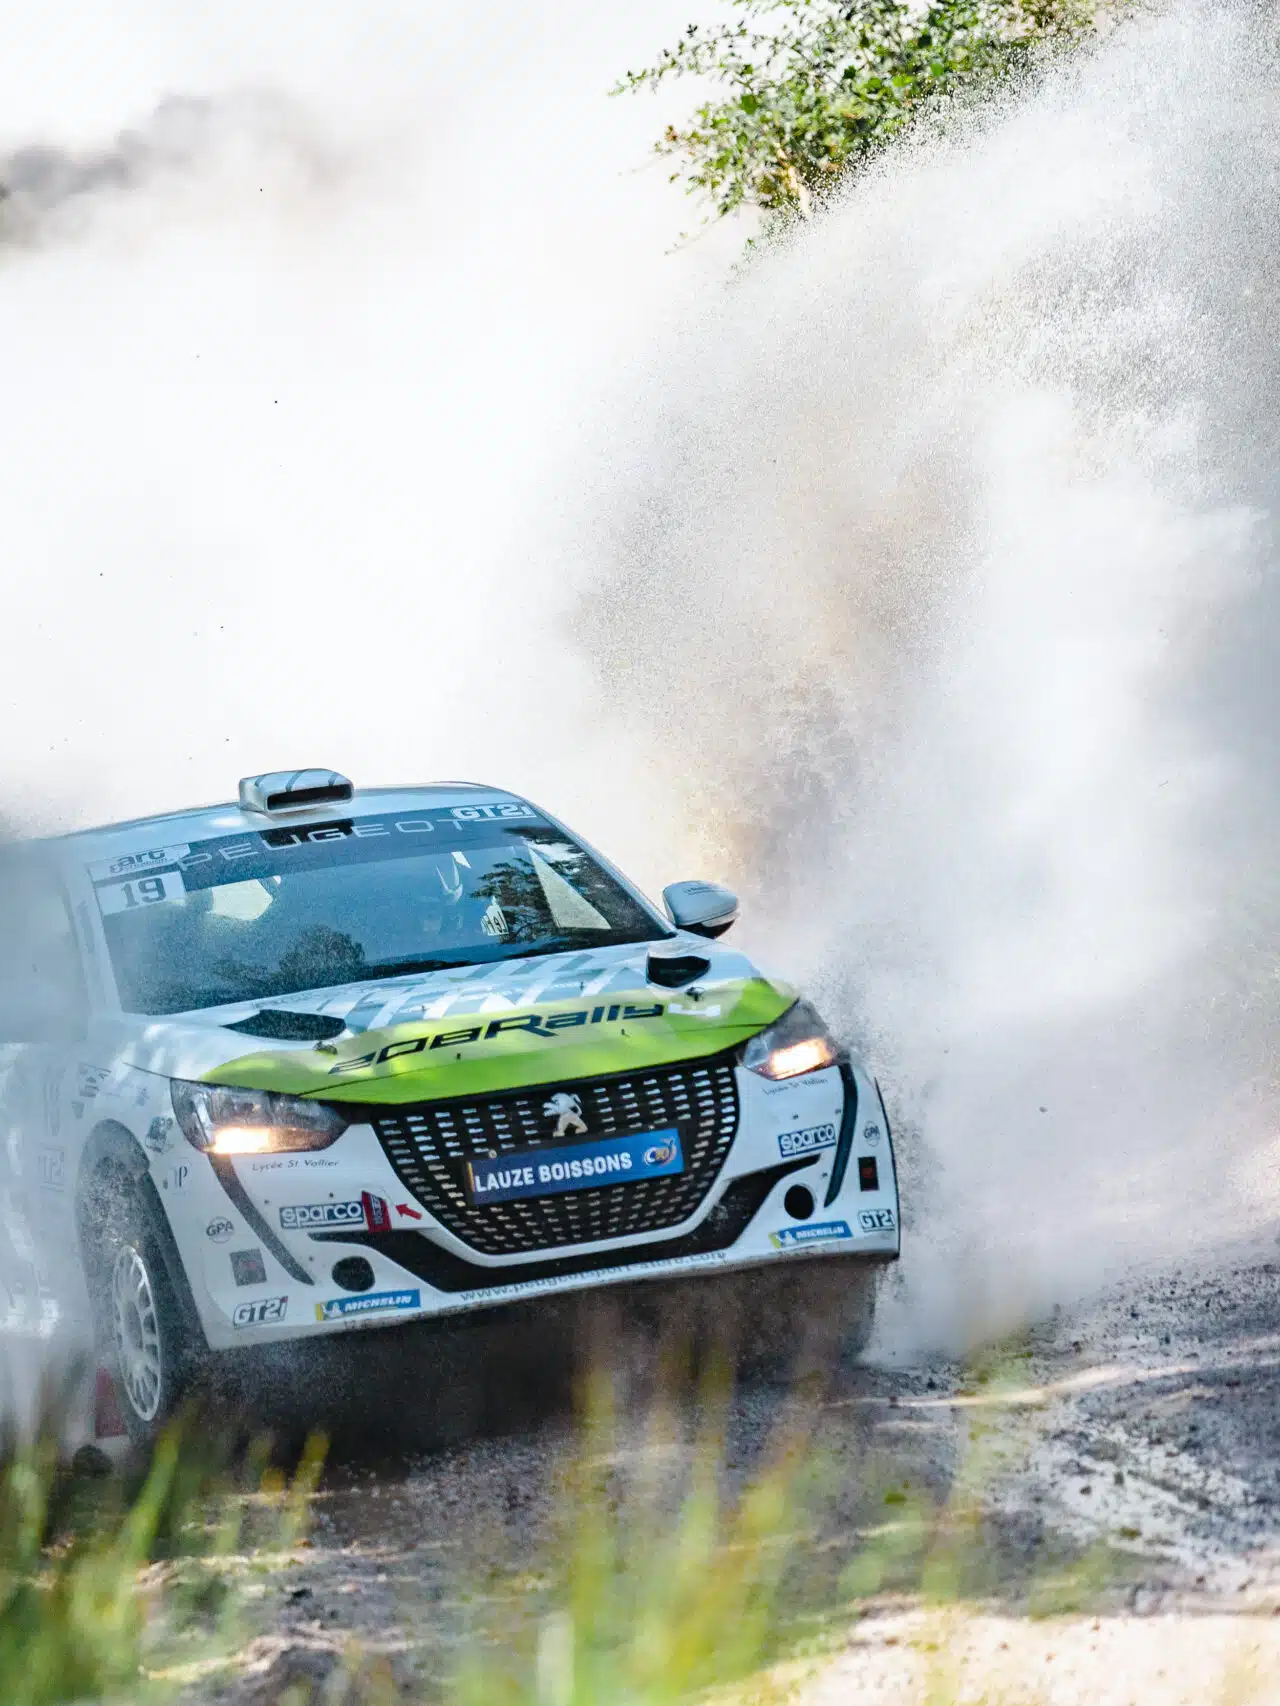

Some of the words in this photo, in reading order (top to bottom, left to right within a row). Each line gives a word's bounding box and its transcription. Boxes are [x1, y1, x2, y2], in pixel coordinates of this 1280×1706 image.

[176, 819, 477, 872] PEUGEOT
[121, 876, 167, 908] 19
[780, 1125, 836, 1154] sparco
[863, 1125, 881, 1141] GPA
[287, 1159, 299, 1168] St
[474, 1166, 535, 1193] LAUZE
[538, 1151, 633, 1184] BOISSONS
[281, 1202, 363, 1228] sparco
[859, 1209, 895, 1231] GT2i
[206, 1221, 234, 1237] GPA
[233, 1297, 288, 1329] GT2i
[344, 1295, 413, 1313] MICHELIN
